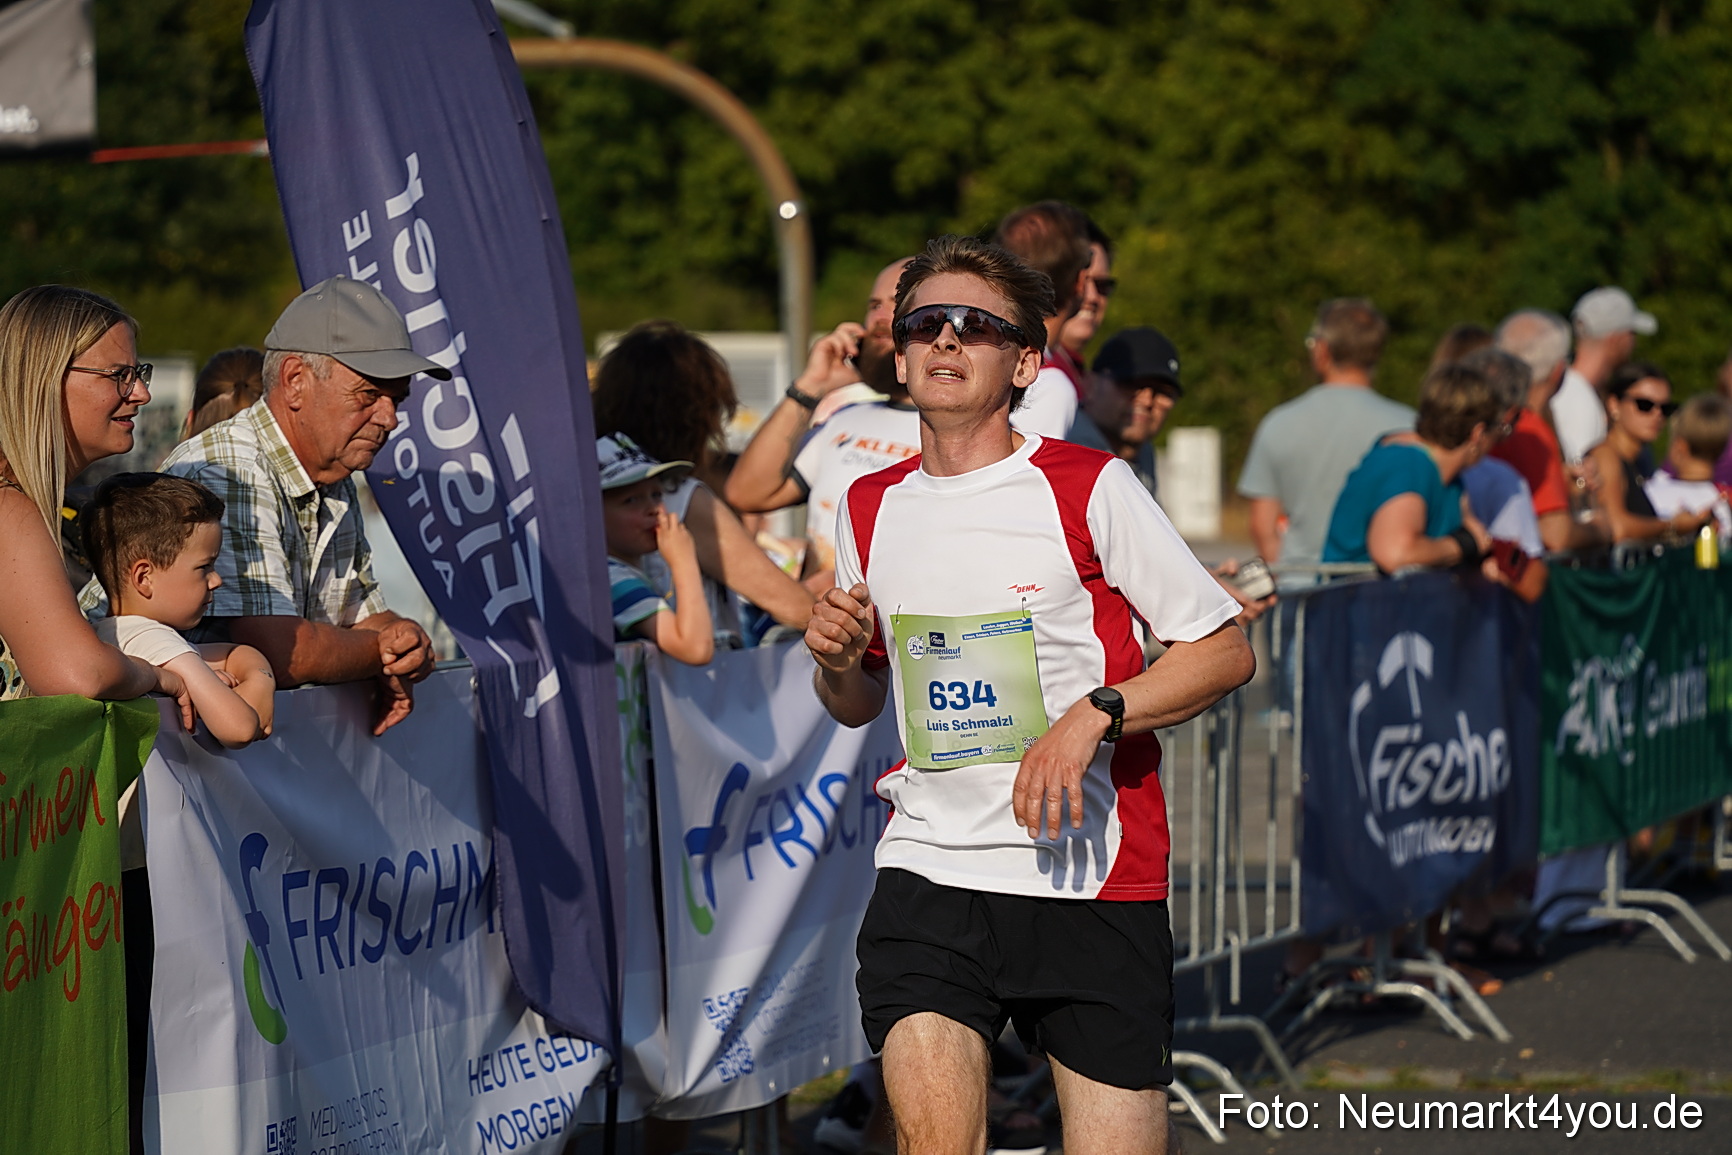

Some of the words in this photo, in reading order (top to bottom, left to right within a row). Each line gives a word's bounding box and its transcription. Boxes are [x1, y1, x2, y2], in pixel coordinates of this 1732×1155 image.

[1016, 583, 1037, 594] DEHN
[926, 646, 961, 655] Firmenlauf
[928, 680, 997, 711] 634
[926, 719, 950, 732] Luis
[952, 715, 1014, 731] Schmalzl
[933, 750, 980, 761] firmenlauf.bayern
[743, 757, 892, 881] FRISCH
[468, 1043, 536, 1096] HEUTE
[477, 1092, 576, 1155] MORGEN
